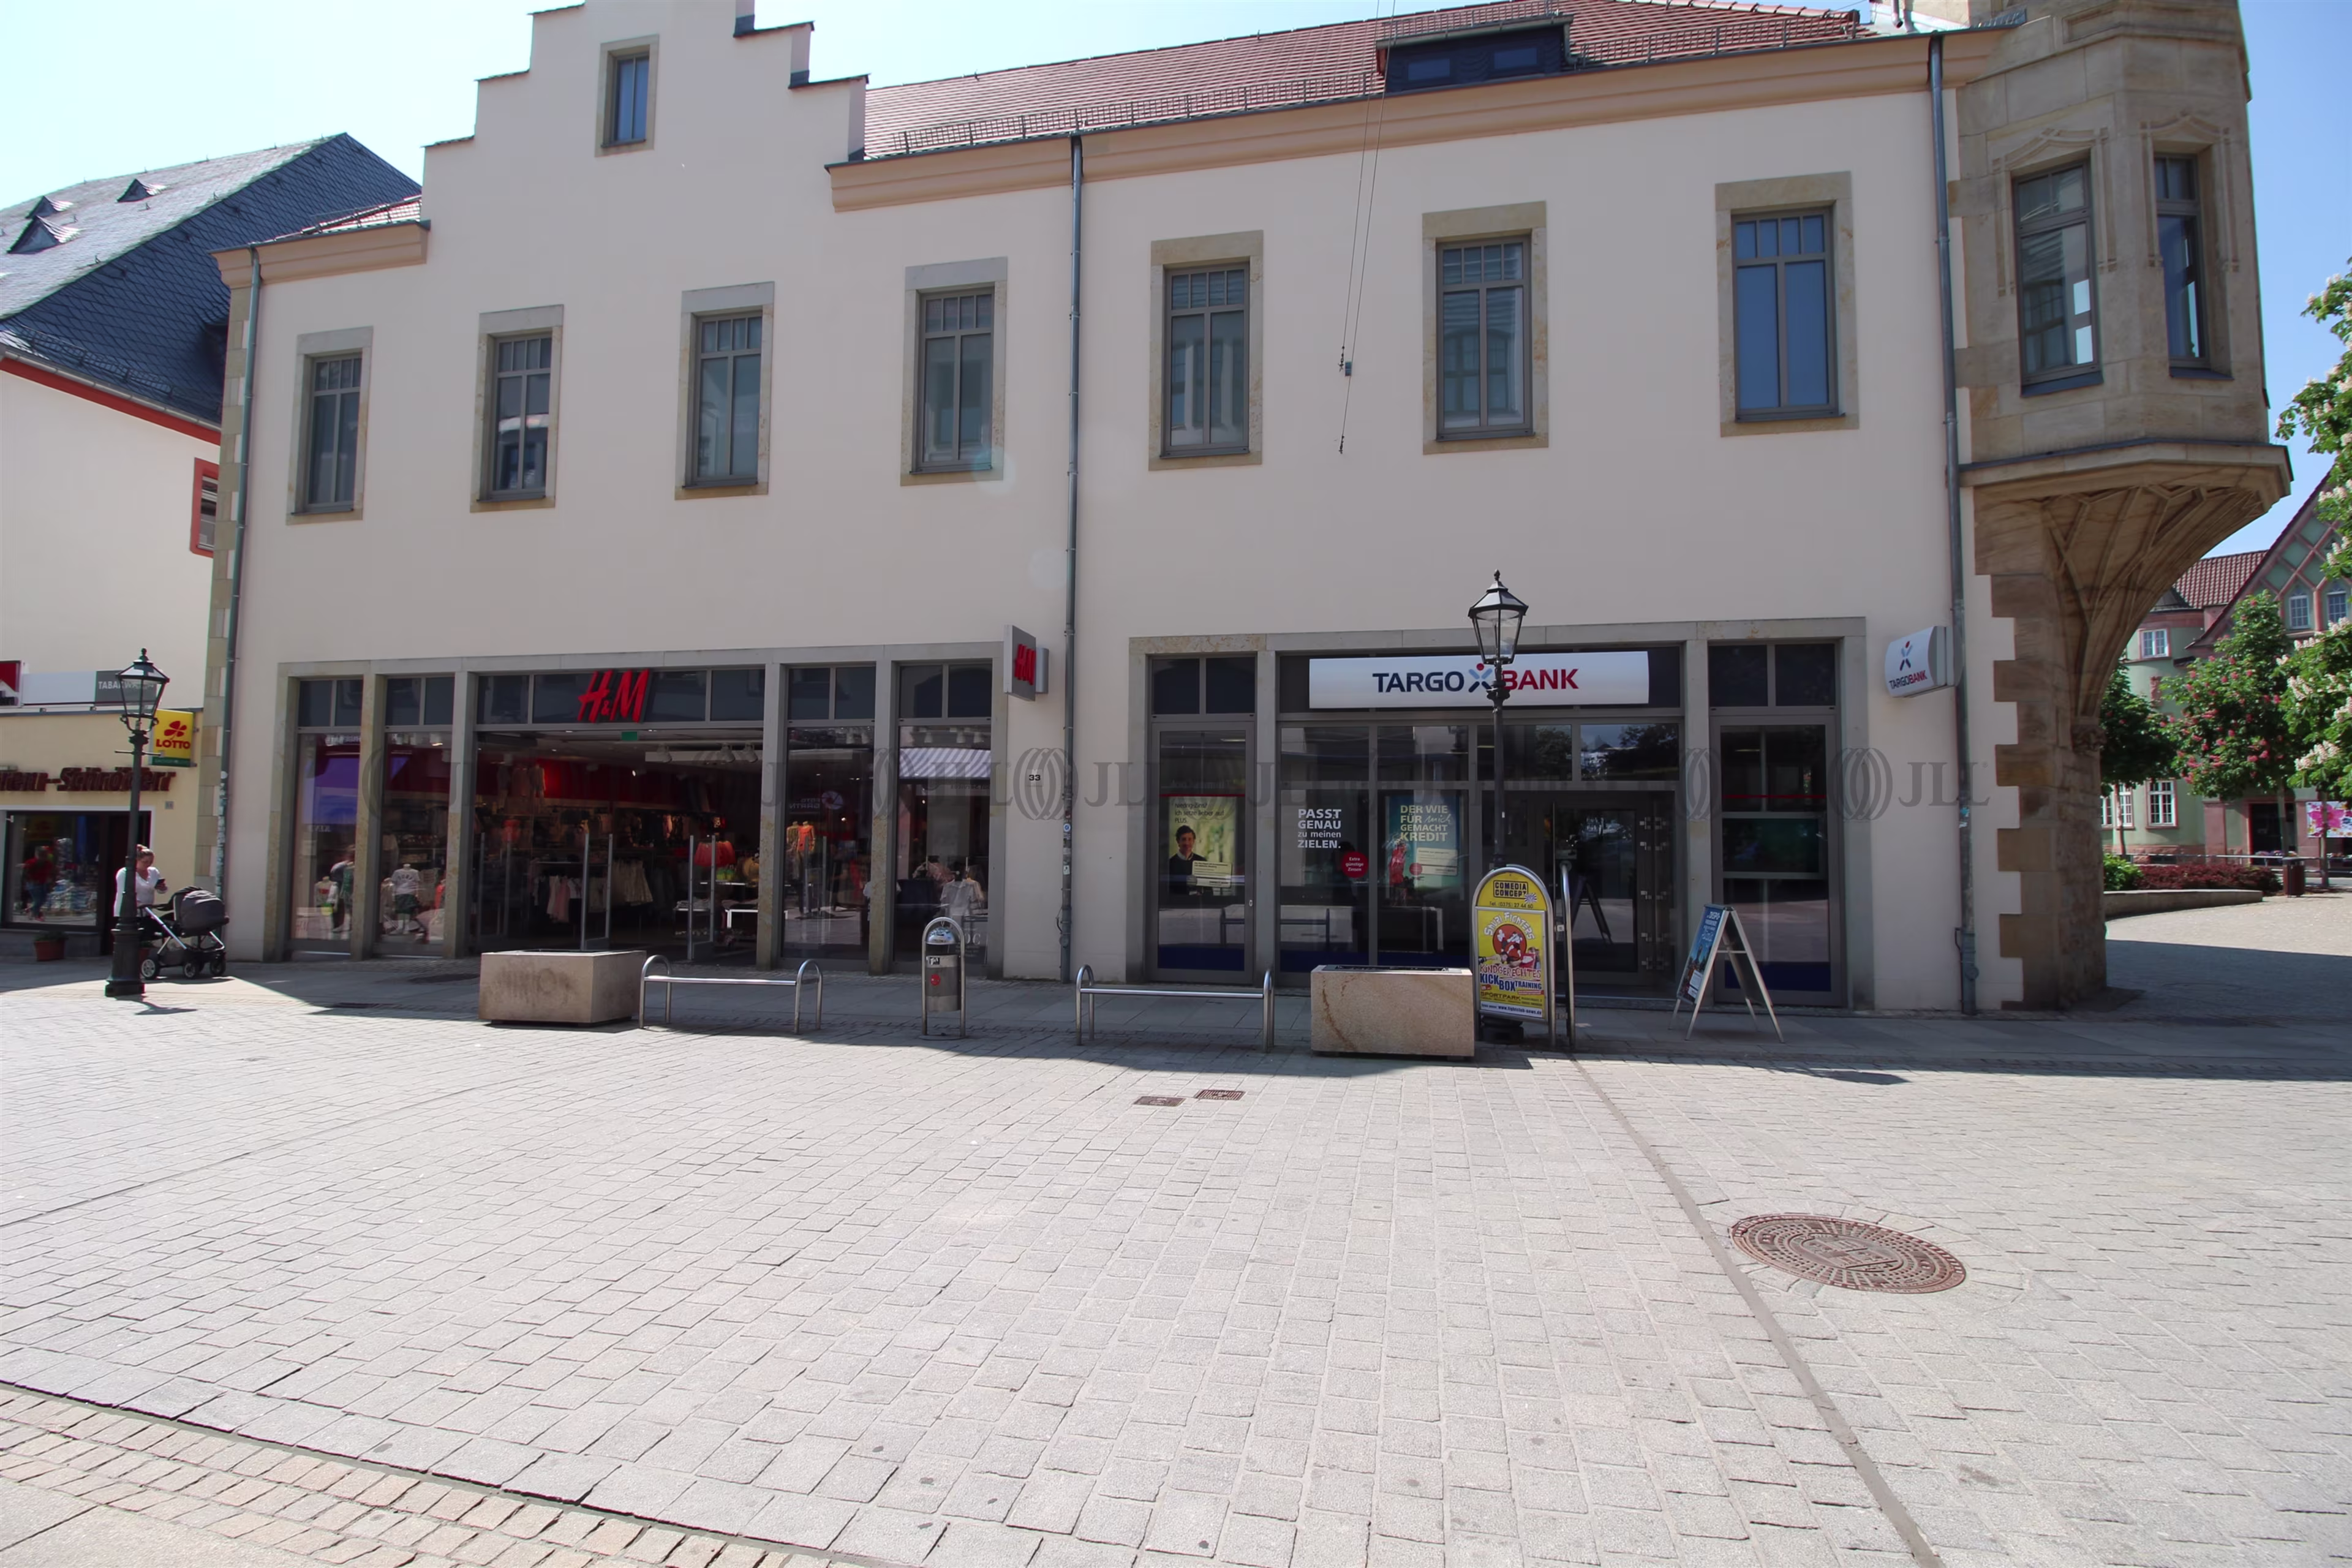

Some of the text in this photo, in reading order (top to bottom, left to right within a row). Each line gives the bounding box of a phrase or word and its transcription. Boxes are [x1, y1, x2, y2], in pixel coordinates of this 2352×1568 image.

[1372, 669, 1579, 693] TARGO BANK
[1888, 670, 1928, 689] TARGOBANK
[577, 668, 650, 724] H&M
[156, 739, 191, 750] LOTTO
[1298, 809, 1341, 818] PASST
[1425, 805, 1448, 813] WIE
[1400, 813, 1452, 824] FÜR mich
[1298, 820, 1341, 829] GENAU
[1400, 832, 1448, 842] KREDIT
[1297, 840, 1341, 848] ZIELEN.
[1480, 973, 1542, 992] KICK BOX TRAINING
[1480, 992, 1520, 1000] SPORTPARK
